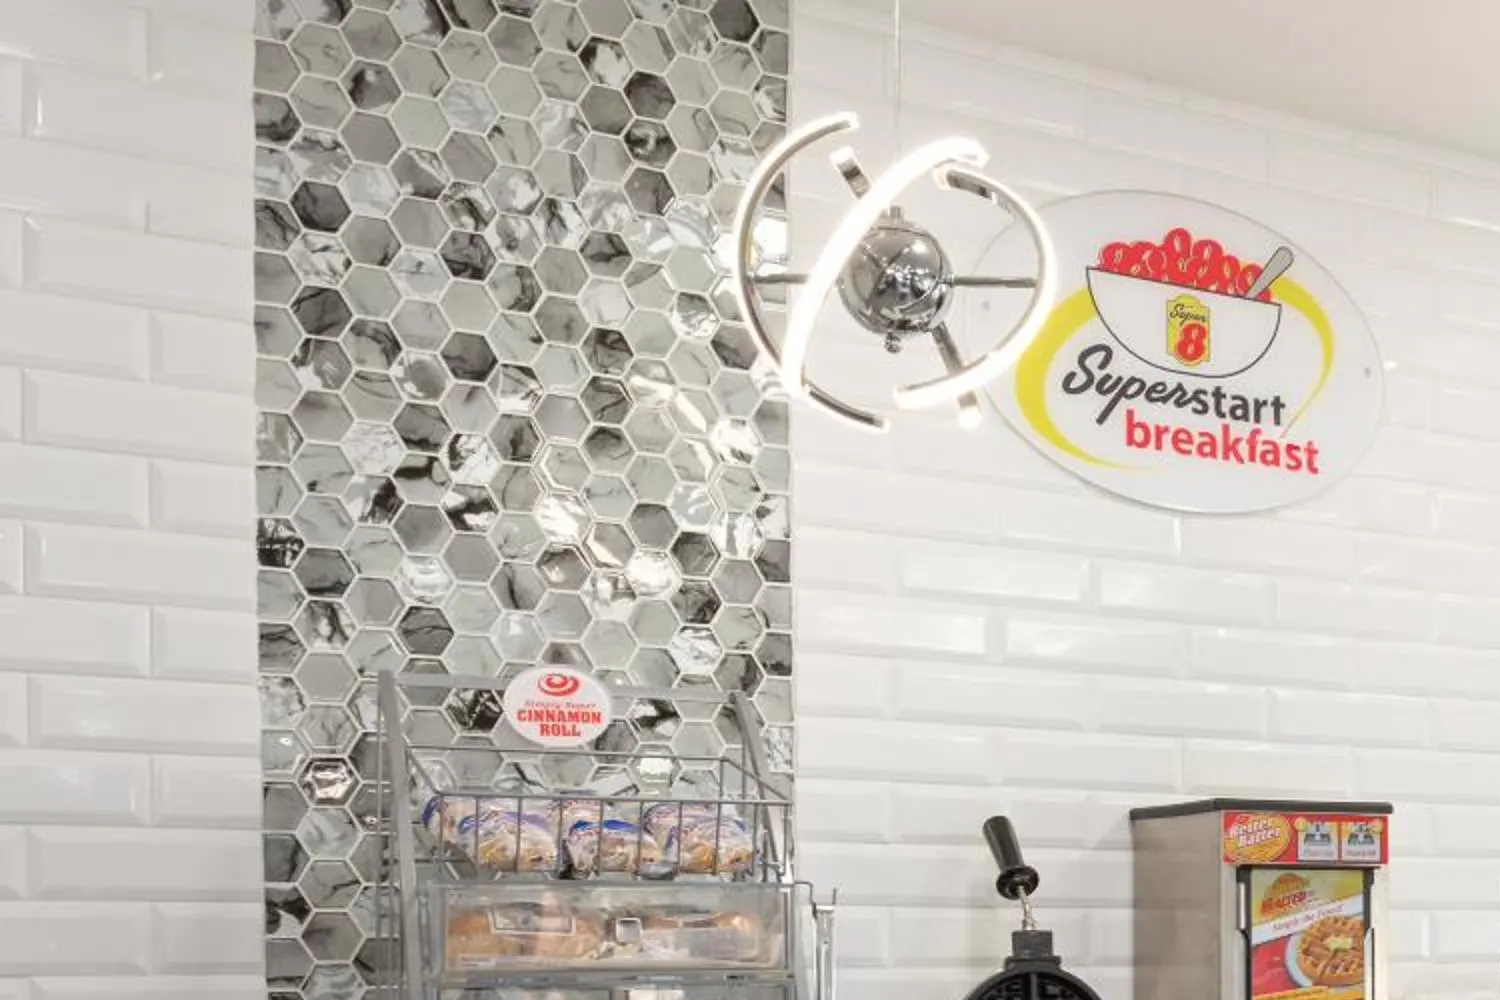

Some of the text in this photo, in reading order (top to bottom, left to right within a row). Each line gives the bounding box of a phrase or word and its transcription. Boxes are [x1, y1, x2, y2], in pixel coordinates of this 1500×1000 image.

[1177, 322, 1207, 361] 8
[1062, 343, 1286, 426] Superstart
[1125, 409, 1320, 475] breakfast
[516, 708, 602, 724] CINNAMON
[540, 723, 581, 737] ROLL
